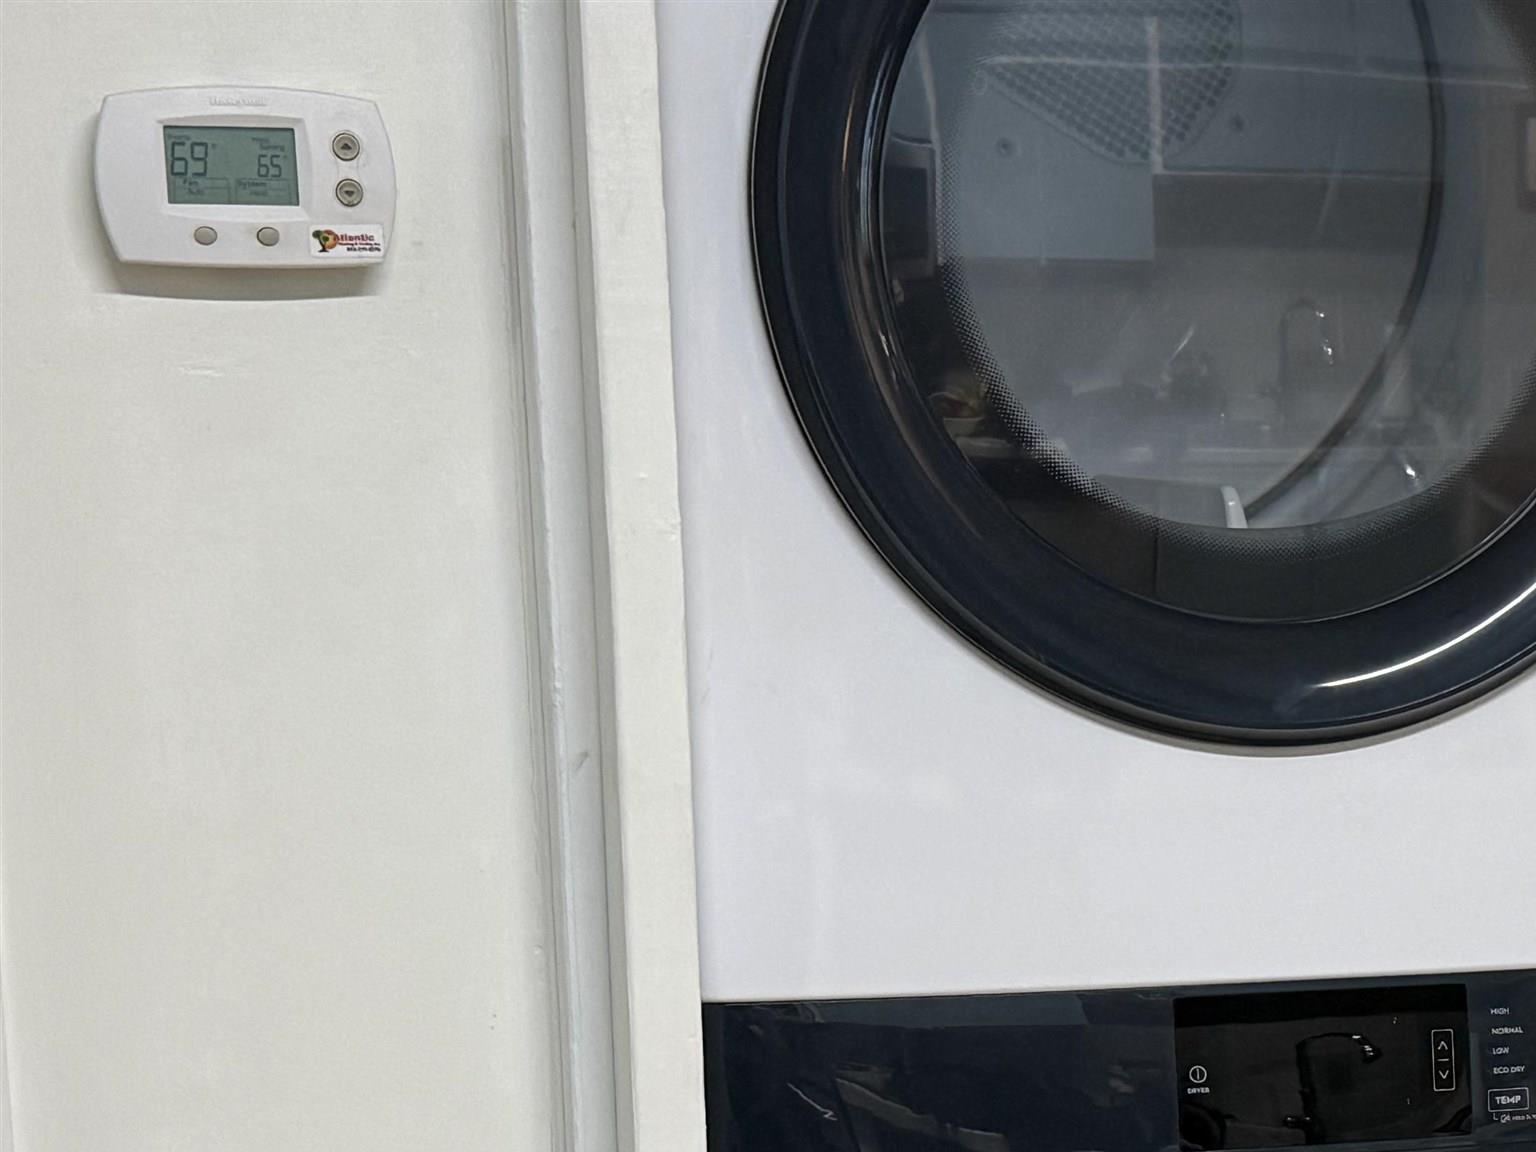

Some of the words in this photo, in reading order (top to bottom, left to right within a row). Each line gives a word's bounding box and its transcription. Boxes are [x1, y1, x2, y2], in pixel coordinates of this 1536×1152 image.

[170, 141, 208, 177] 69
[257, 154, 282, 178] 65
[1490, 1007, 1510, 1015] HIGH
[1491, 1026, 1524, 1035] NORMAL
[1492, 1046, 1510, 1055] LOW
[1493, 1066, 1509, 1075] ECO
[1510, 1065, 1525, 1073] DRY
[1495, 1095, 1521, 1104] TEMP
